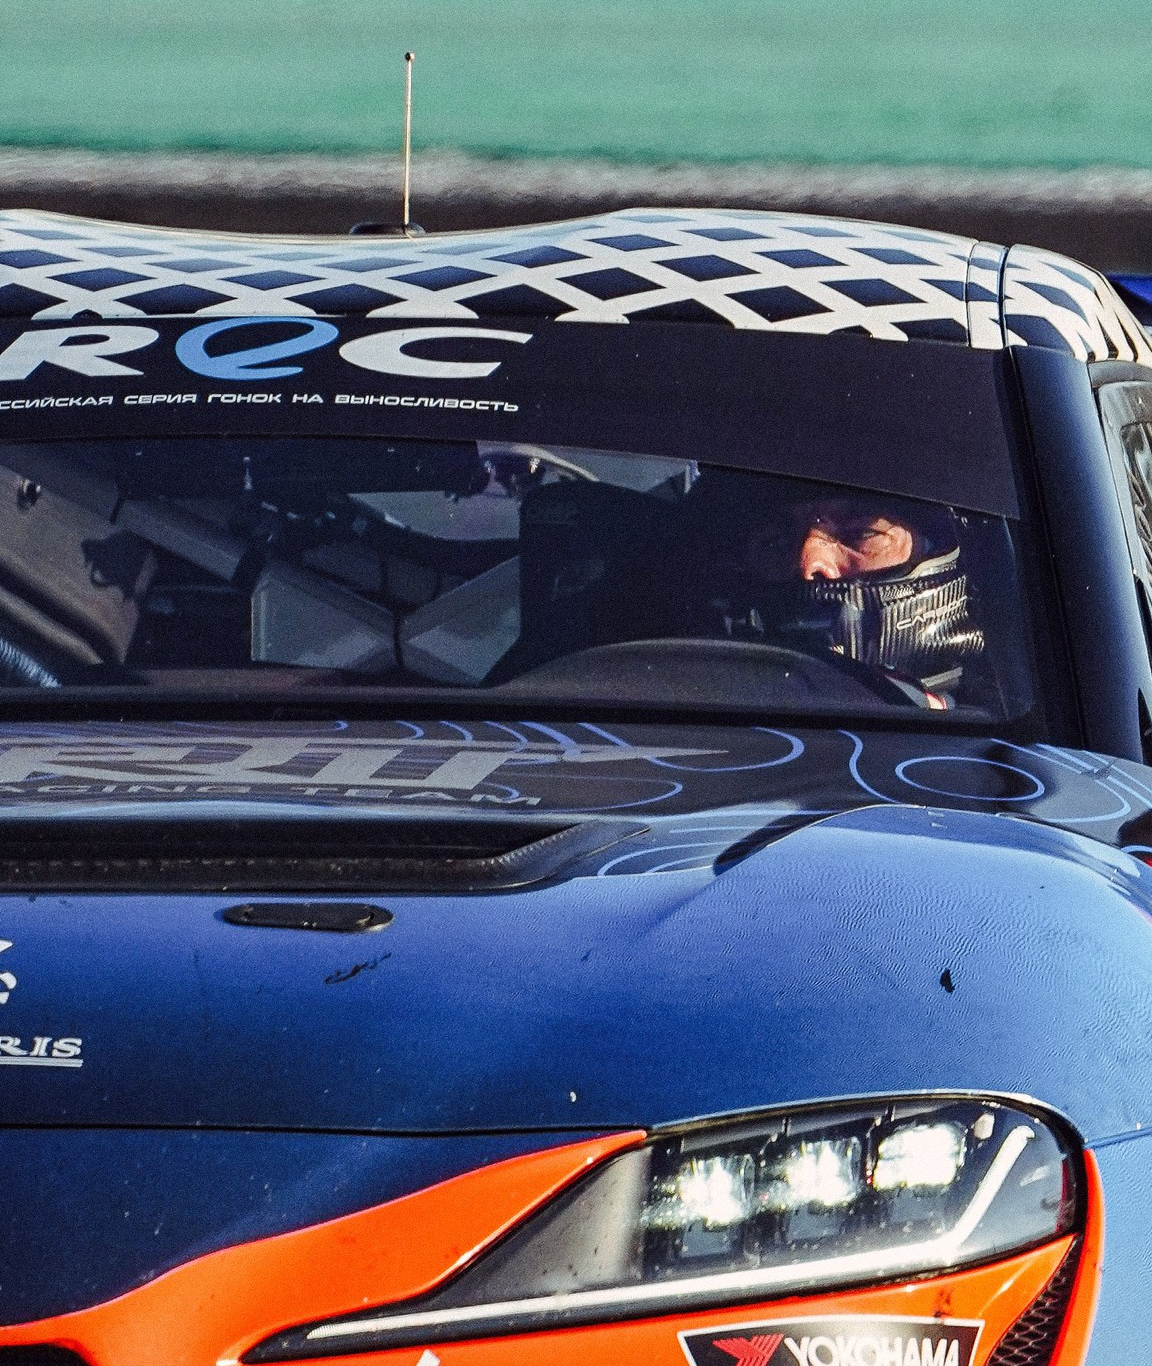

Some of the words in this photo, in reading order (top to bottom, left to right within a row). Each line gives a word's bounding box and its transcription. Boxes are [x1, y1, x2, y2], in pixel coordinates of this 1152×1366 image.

[123, 393, 198, 405] СЕРИЯ
[207, 393, 282, 404] ГОНОК
[291, 393, 324, 404] НА
[334, 394, 519, 412] ВЫНОСЛИВОСТЬ
[290, 786, 542, 806] TEAM
